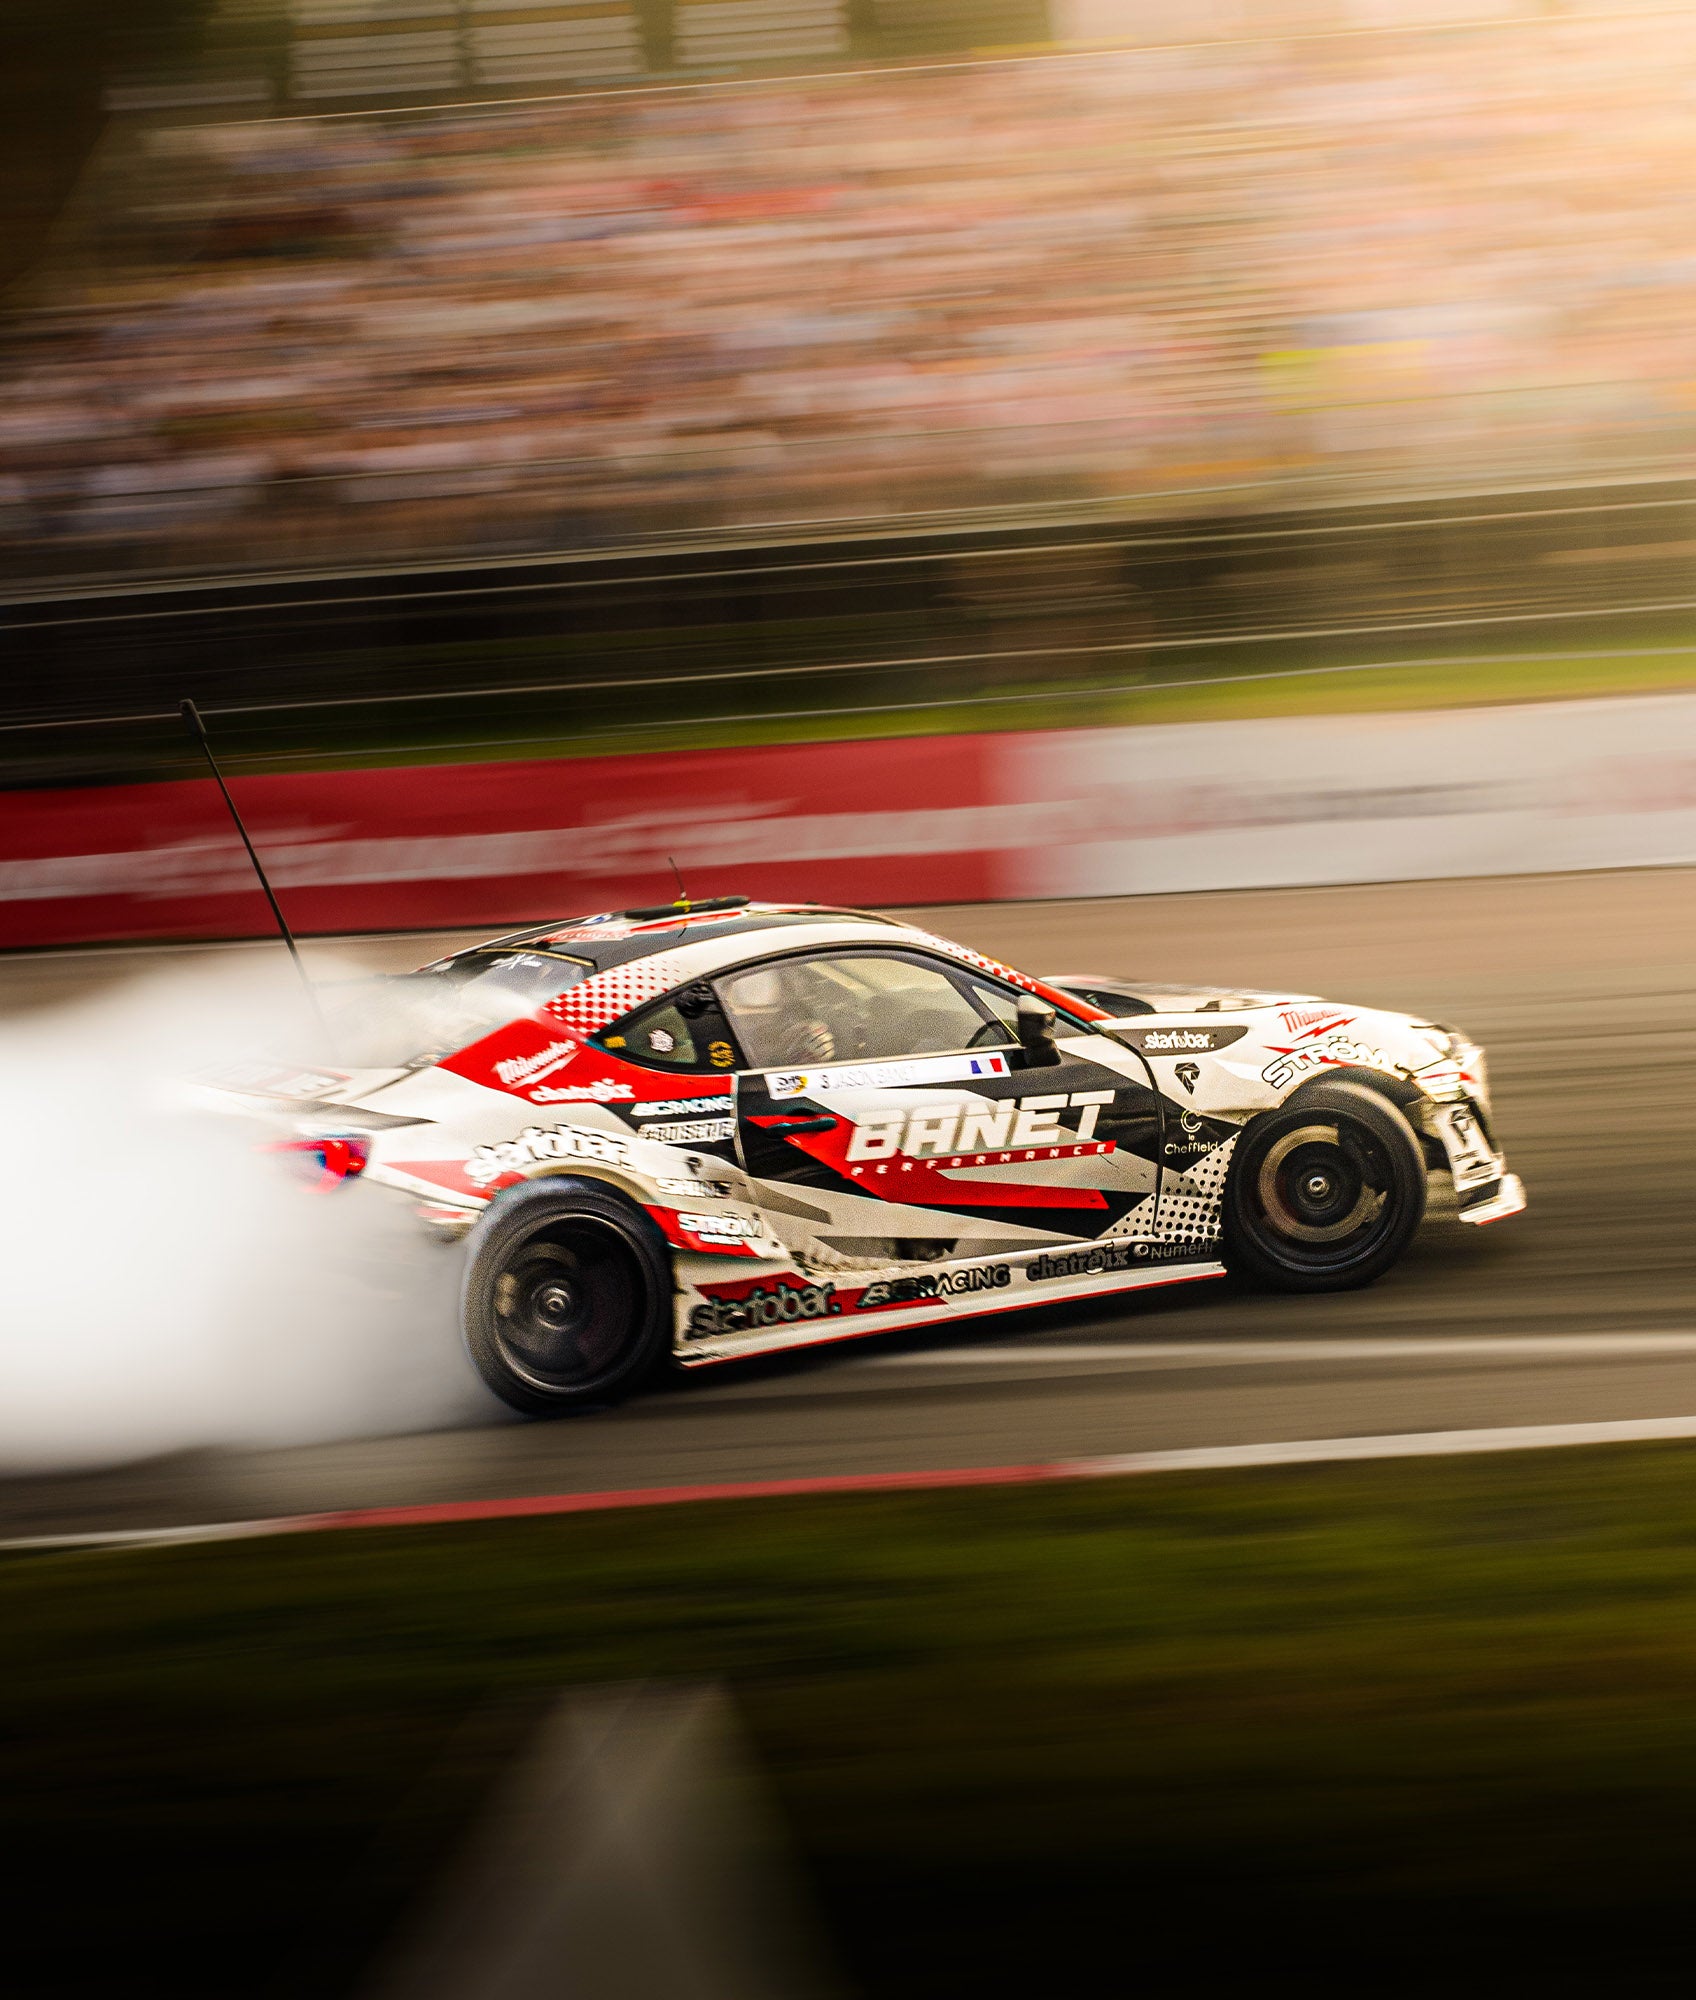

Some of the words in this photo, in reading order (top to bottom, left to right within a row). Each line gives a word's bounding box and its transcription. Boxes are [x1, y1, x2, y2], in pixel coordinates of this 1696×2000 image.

[845, 1089, 1116, 1162] BANET
[850, 1143, 1106, 1177] PERFORMANCE
[1164, 1141, 1218, 1155] Cheffield
